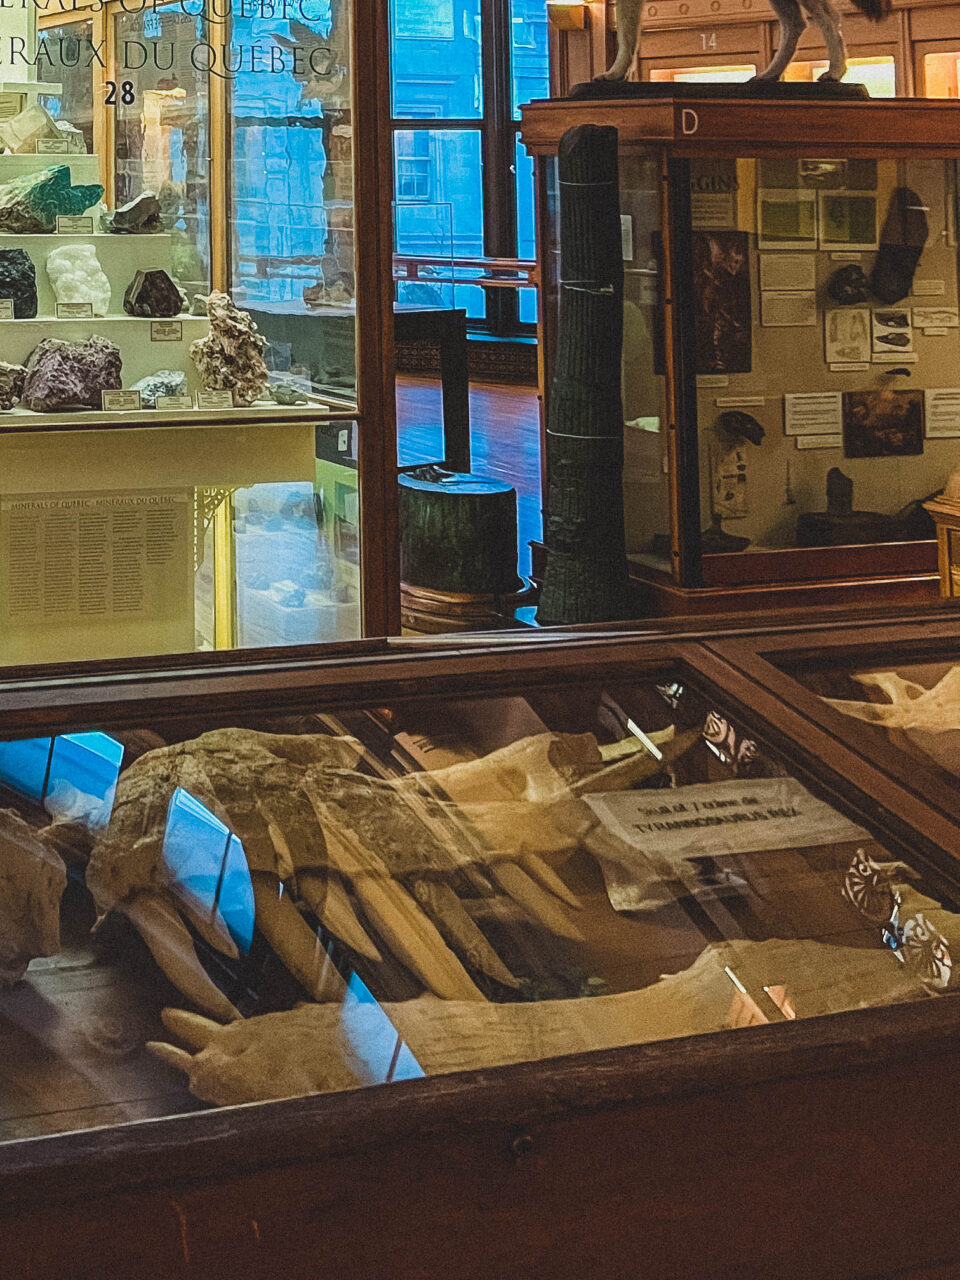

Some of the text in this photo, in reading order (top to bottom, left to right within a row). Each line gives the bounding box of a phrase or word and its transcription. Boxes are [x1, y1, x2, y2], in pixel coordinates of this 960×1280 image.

[700, 33, 718, 50] 14
[123, 40, 175, 71] DU
[190, 39, 333, 80] QUÉBEC
[104, 80, 136, 106] 28
[682, 108, 699, 135] D
[11, 501, 49, 510] MINERALS
